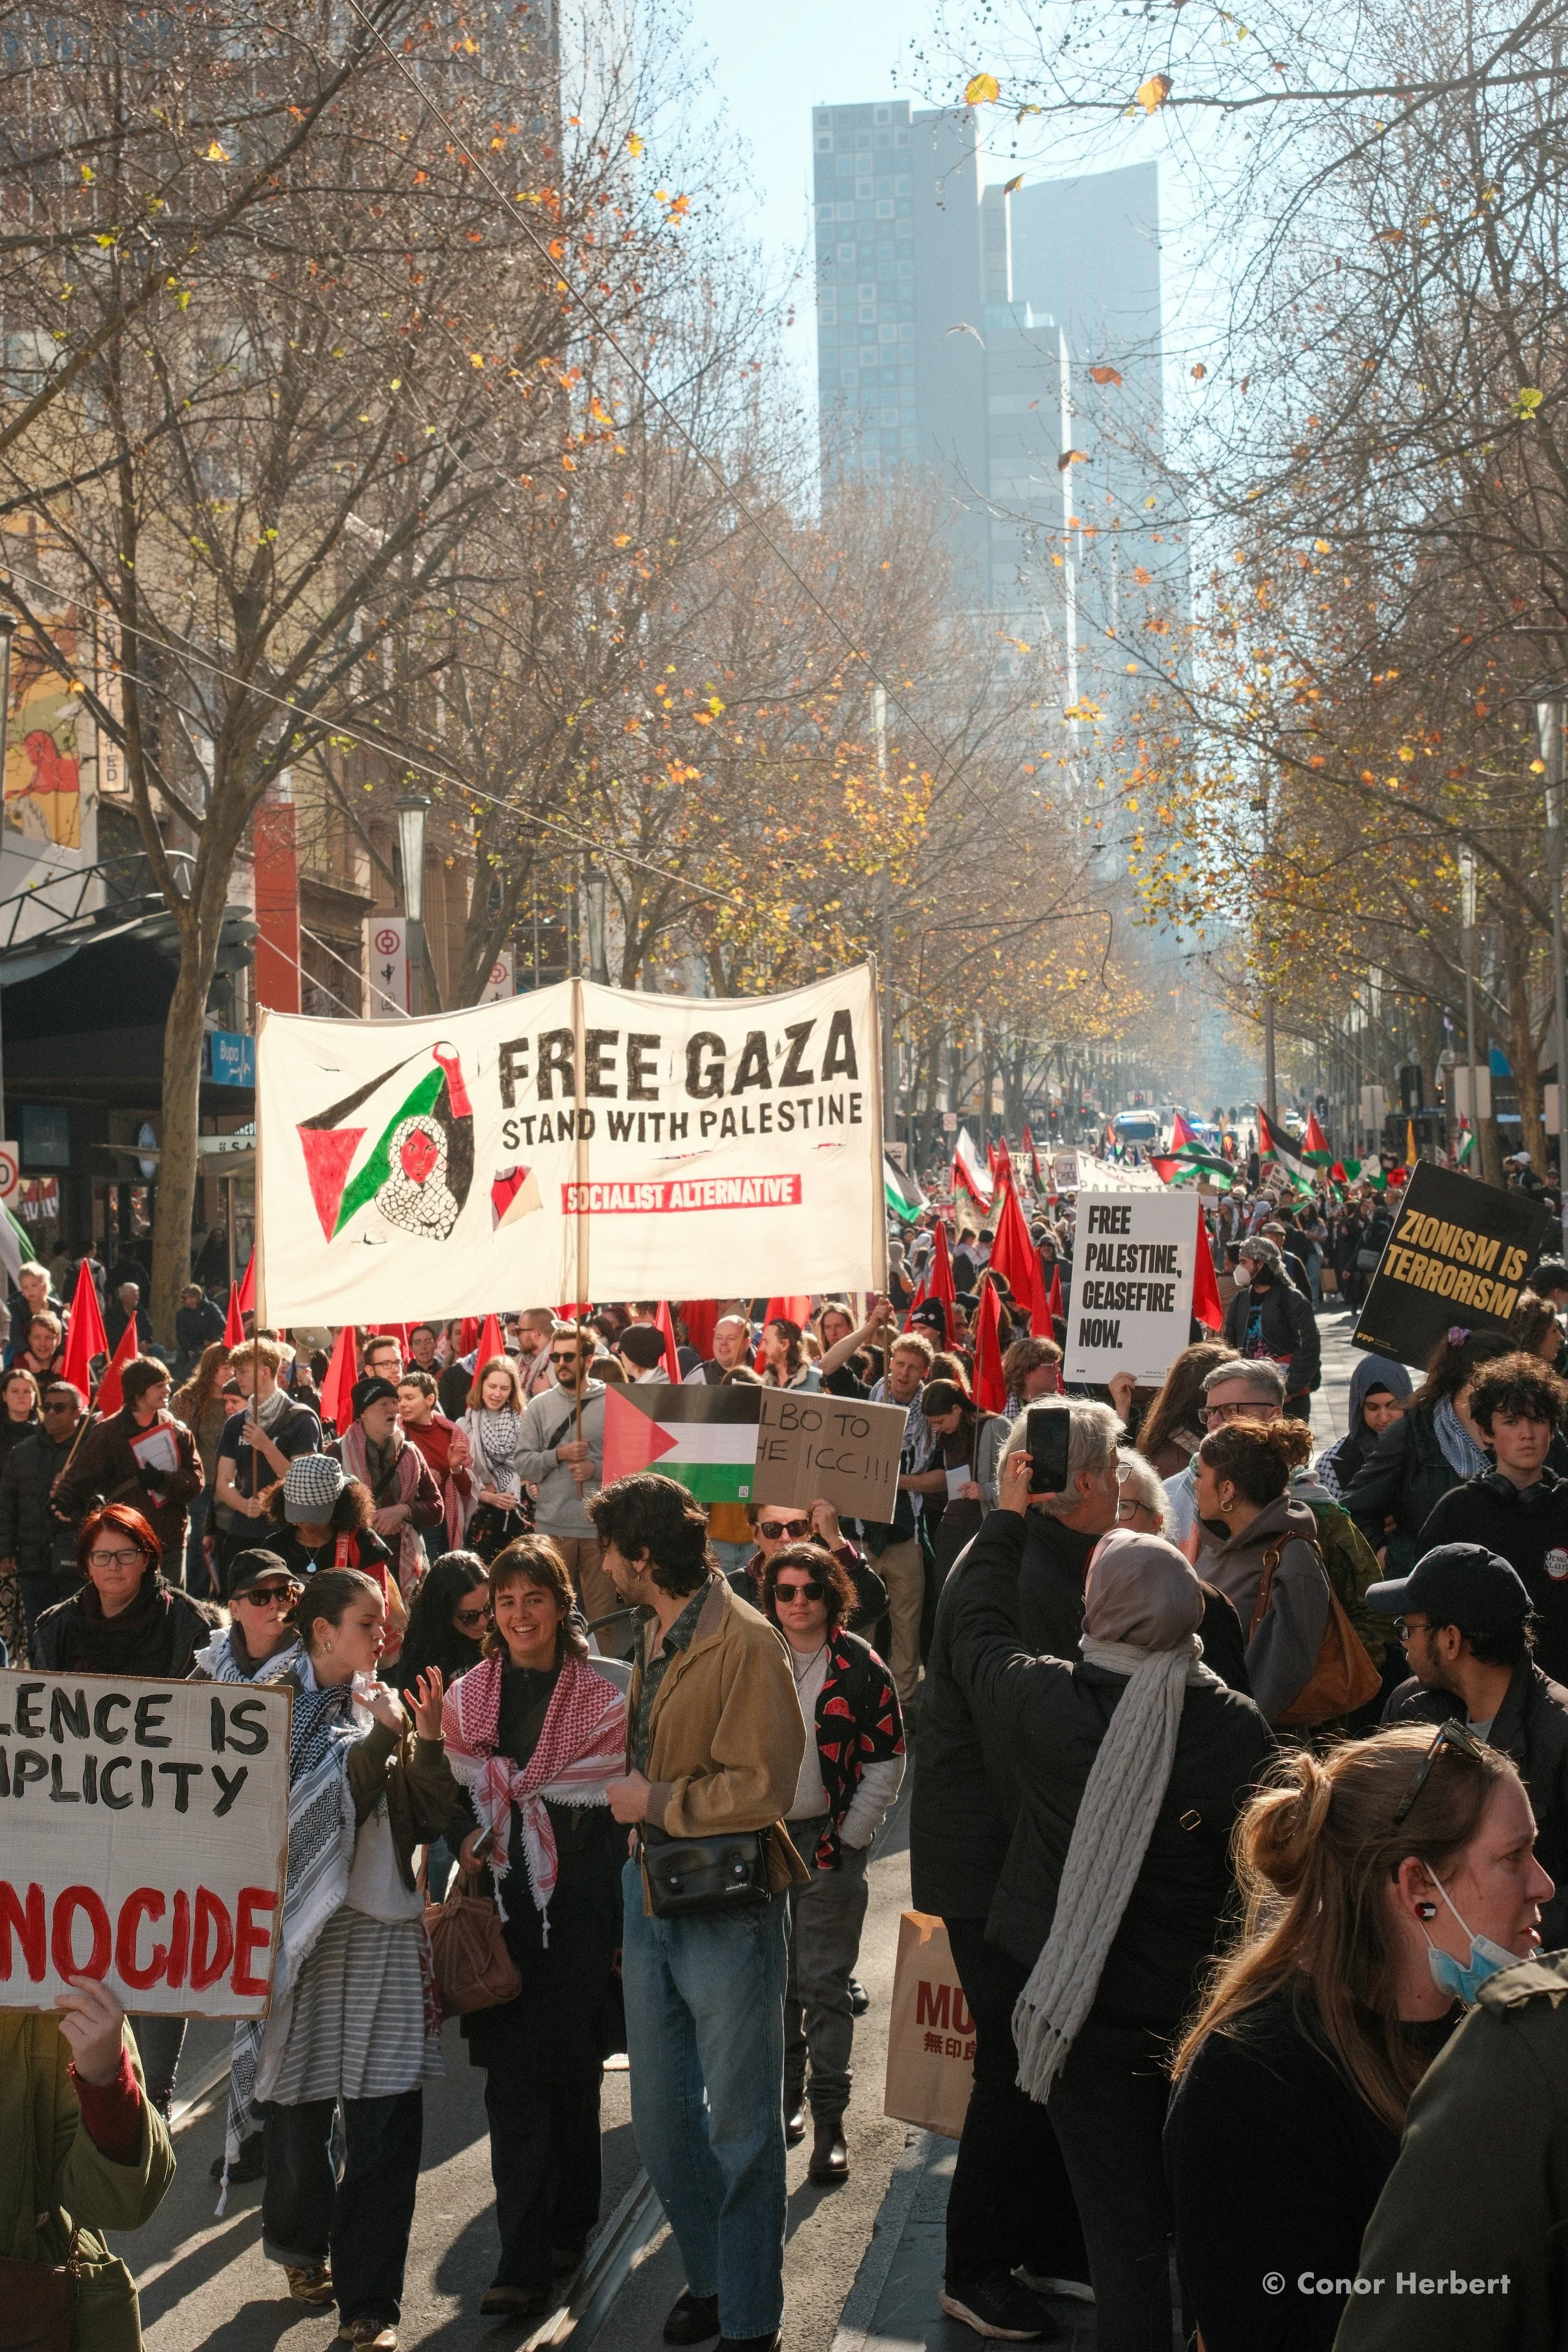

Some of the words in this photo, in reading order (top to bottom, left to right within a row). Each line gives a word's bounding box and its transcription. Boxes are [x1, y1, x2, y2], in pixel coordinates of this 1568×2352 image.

[499, 1027, 661, 1109] FREE
[686, 1008, 859, 1098] GAZA
[502, 1108, 595, 1150] STAND
[608, 1109, 688, 1143] WITH
[701, 1091, 863, 1138] PALESTINE
[566, 1182, 665, 1212] SOCIALIST
[669, 1176, 794, 1209] ALTERNATIVE
[1088, 1205, 1131, 1234] FREE
[1085, 1243, 1182, 1278] PALESTINE,
[1397, 1209, 1501, 1273] ZIONISM
[1500, 1245, 1528, 1281] IS
[1082, 1281, 1174, 1313] CEASEFIRE
[1383, 1244, 1518, 1319] TERRORISM
[1078, 1318, 1123, 1348] NOW.
[1357, 1332, 1375, 1343] FPP
[834, 1414, 871, 1438] TO
[1544, 1551, 1568, 1563] DEMO
[210, 1696, 269, 1756] IS
[725, 1882, 748, 1892] minolta
